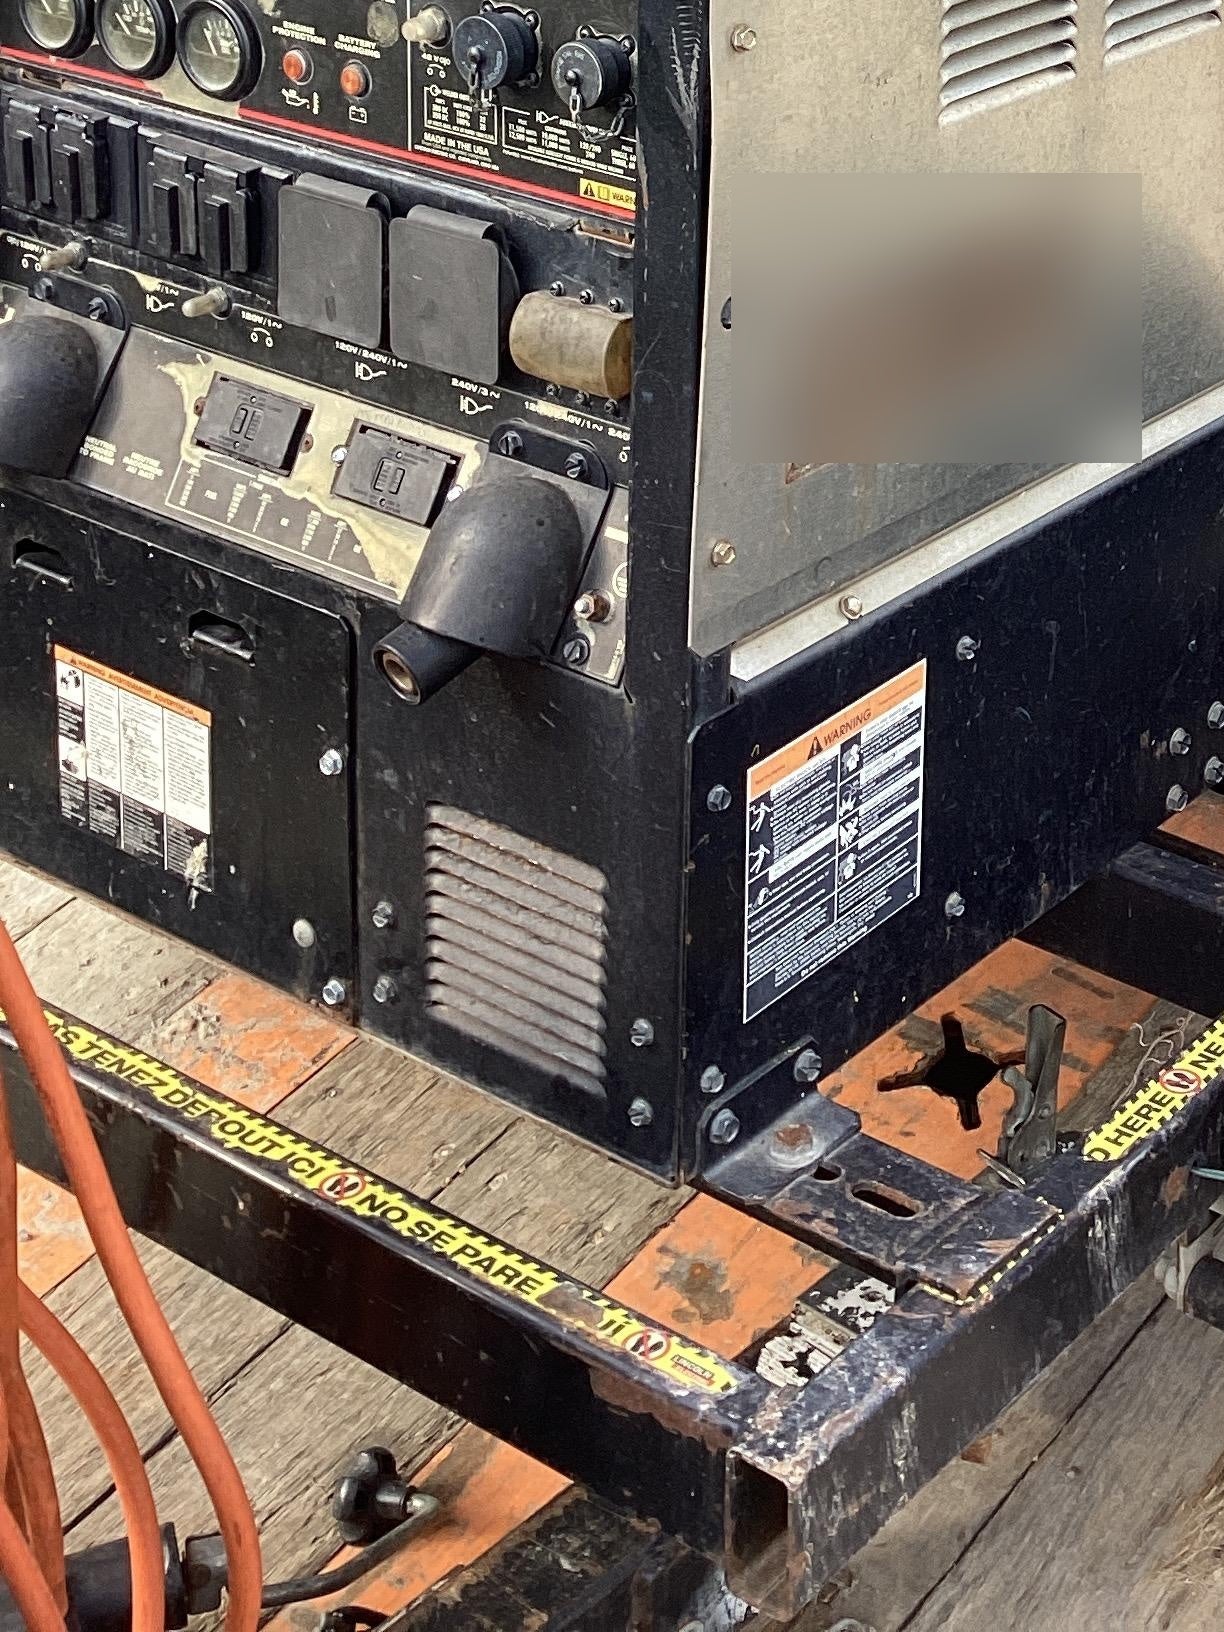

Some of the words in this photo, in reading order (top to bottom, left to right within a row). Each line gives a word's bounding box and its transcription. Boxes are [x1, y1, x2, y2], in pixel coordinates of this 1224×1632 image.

[271, 25, 327, 46] PROTECTION
[282, 20, 316, 35] ENGINE
[333, 41, 381, 59] CHARGING
[337, 33, 377, 50] BATTERY
[423, 131, 447, 146] MADE
[446, 138, 456, 148] IN
[456, 140, 473, 153] THE
[472, 144, 490, 157] USA
[823, 707, 872, 747] WARNING
[78, 1039, 170, 1090] TENEZ
[283, 1150, 326, 1180] ICI
[1106, 1090, 1172, 1145] HERE
[358, 1193, 409, 1224] NO
[408, 1218, 457, 1251] SE
[450, 1242, 545, 1297] PARE
